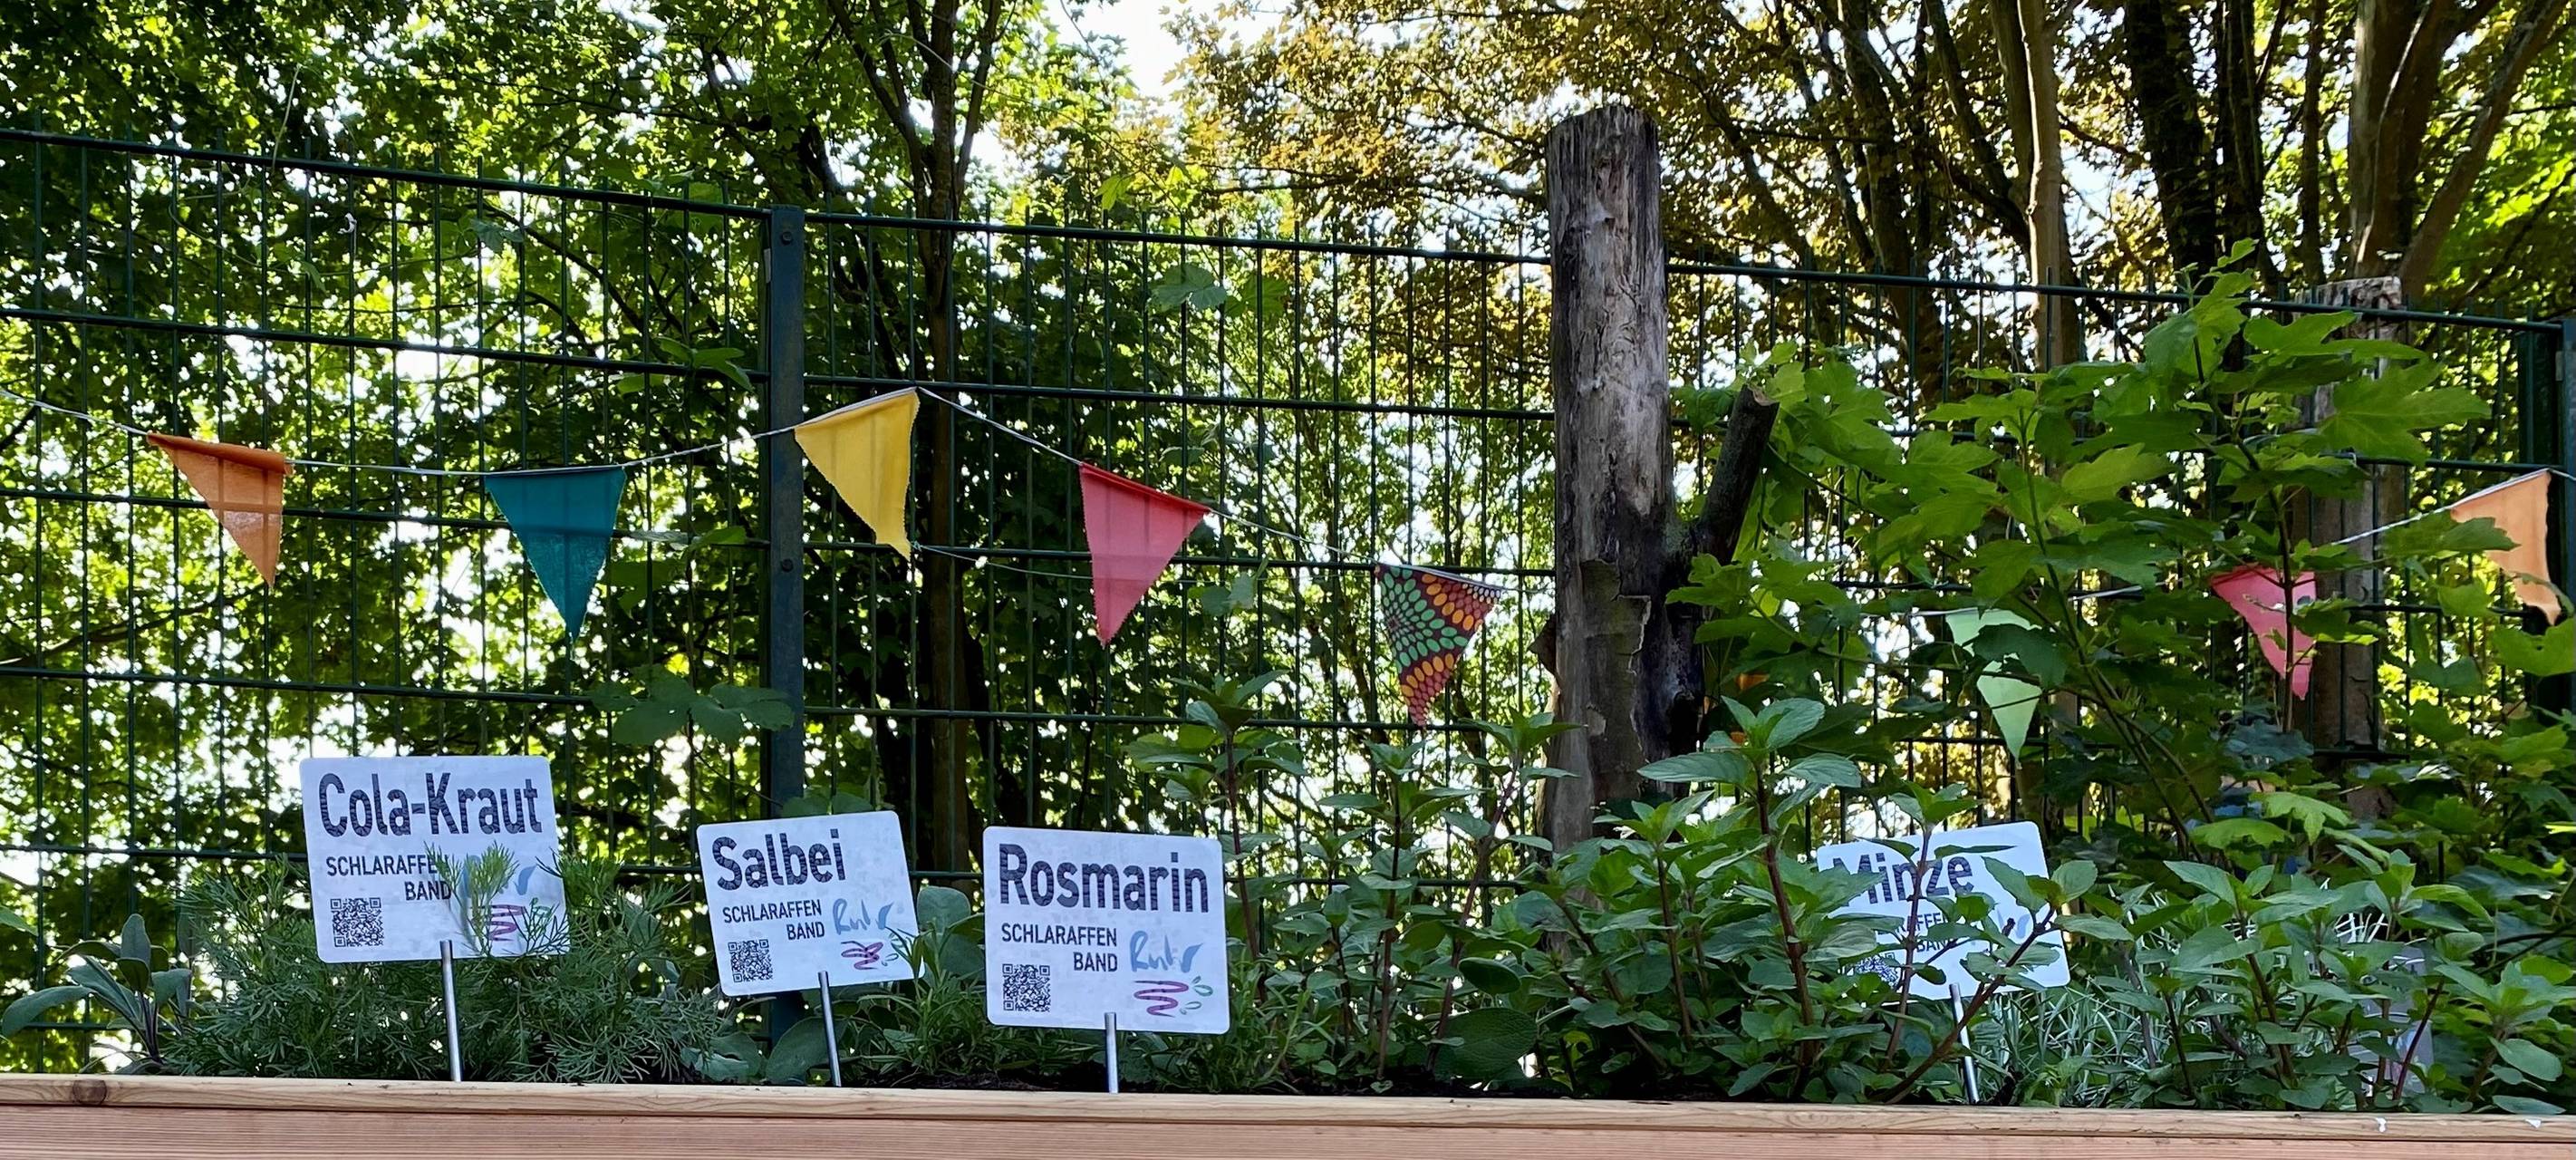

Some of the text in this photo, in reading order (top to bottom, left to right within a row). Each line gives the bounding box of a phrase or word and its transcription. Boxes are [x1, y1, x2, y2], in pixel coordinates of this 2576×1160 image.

[319, 772, 543, 837] Cola-Kraut
[712, 828, 846, 891] Salbei
[999, 843, 1209, 913] Rosmarin
[404, 881, 452, 901] BAND
[723, 899, 822, 923] SCHLARAFFEN
[786, 922, 825, 941] BAND
[1001, 923, 1117, 947] SCHLARAFFEN
[1073, 952, 1118, 972] BAND
